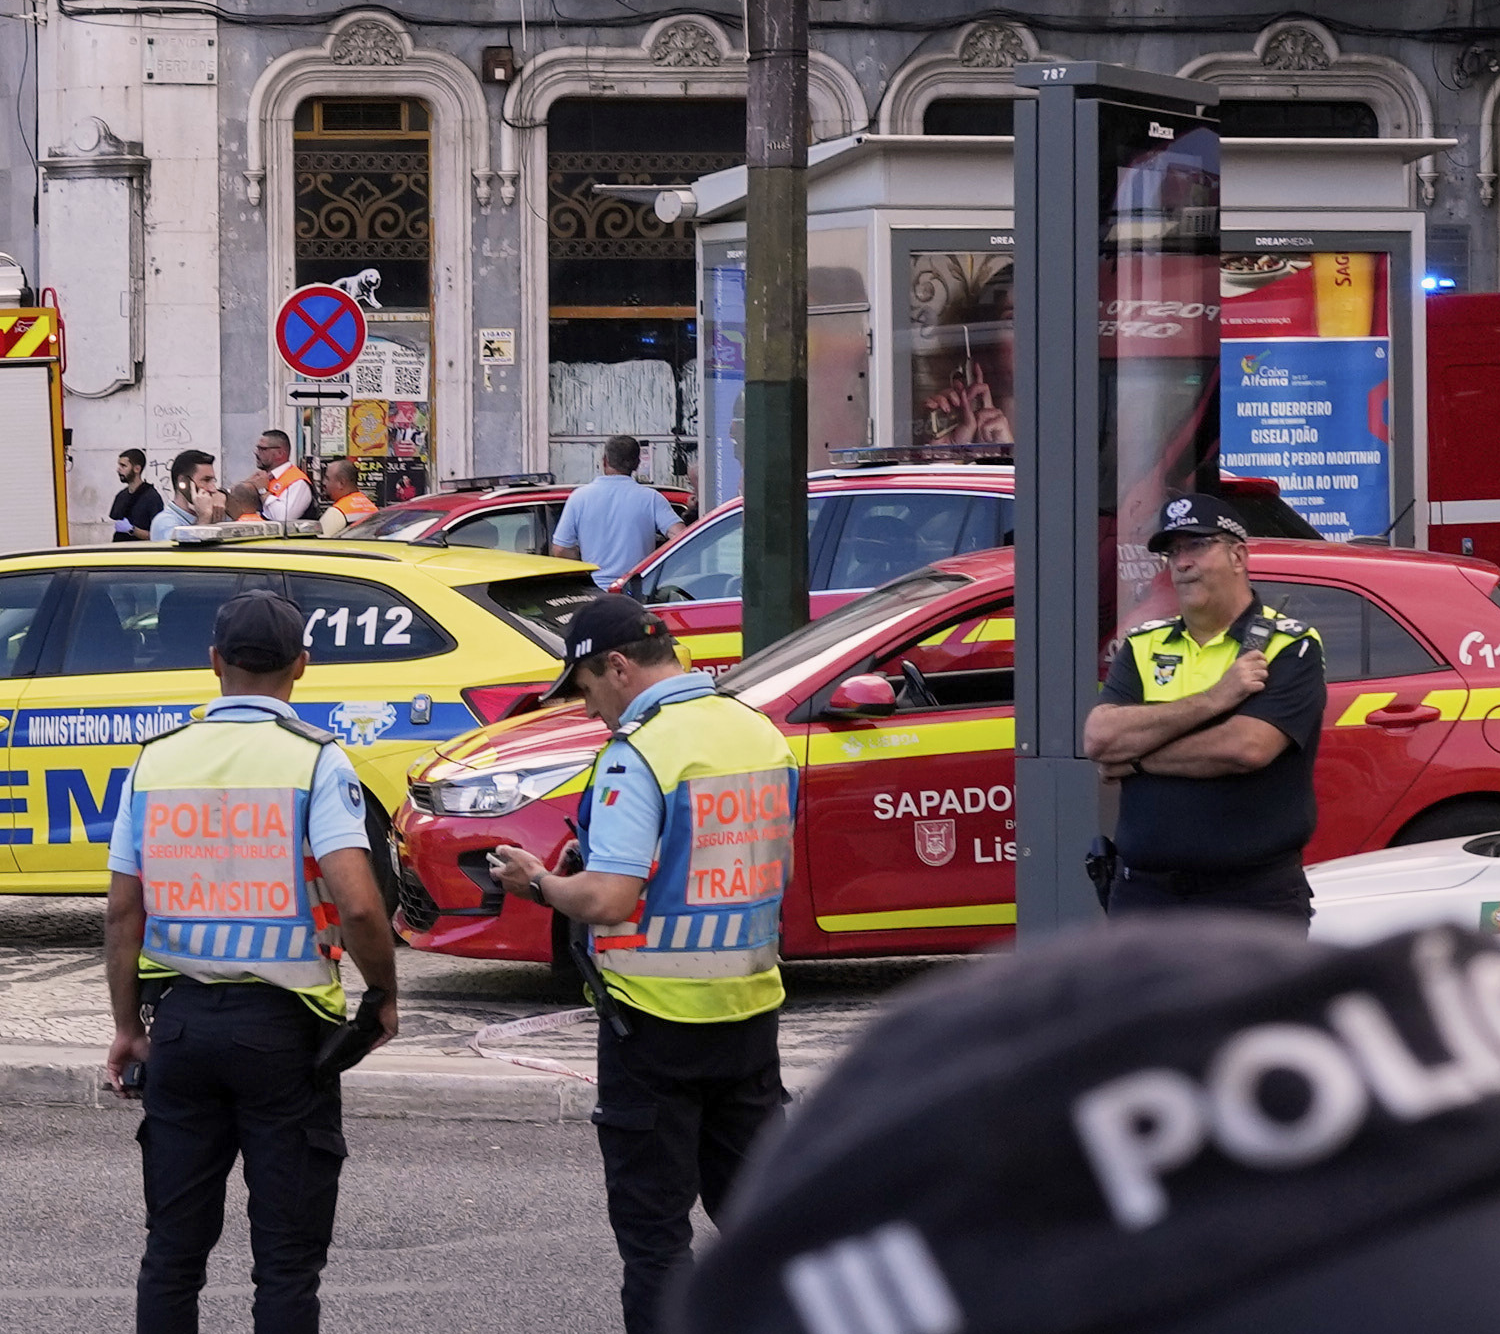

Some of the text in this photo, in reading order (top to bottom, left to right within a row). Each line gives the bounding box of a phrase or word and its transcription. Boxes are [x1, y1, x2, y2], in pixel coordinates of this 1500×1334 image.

[1041, 67, 1067, 81] 787
[1241, 375, 1289, 387] Alfama
[1259, 366, 1289, 377] Caixa
[1237, 400, 1332, 417] KATIA GUERREIRO
[1251, 425, 1318, 445] GISELA JOÃO
[1227, 452, 1281, 467] MOUTINHO
[1291, 451, 1325, 466] PEDRO
[1326, 449, 1381, 465] MOUTINHO
[1316, 475, 1331, 490] AO
[1333, 474, 1359, 490] VIVO
[326, 605, 414, 647] 112
[28, 709, 109, 746] MINISTÉRIO
[112, 716, 132, 745] DA
[869, 733, 920, 748] LISBOA
[873, 784, 1016, 820] SAPADO
[149, 792, 287, 840] POLÍCIA
[149, 841, 288, 864] SEGURANÇA PÚBLICA
[149, 872, 290, 912] TRÂNSITO
